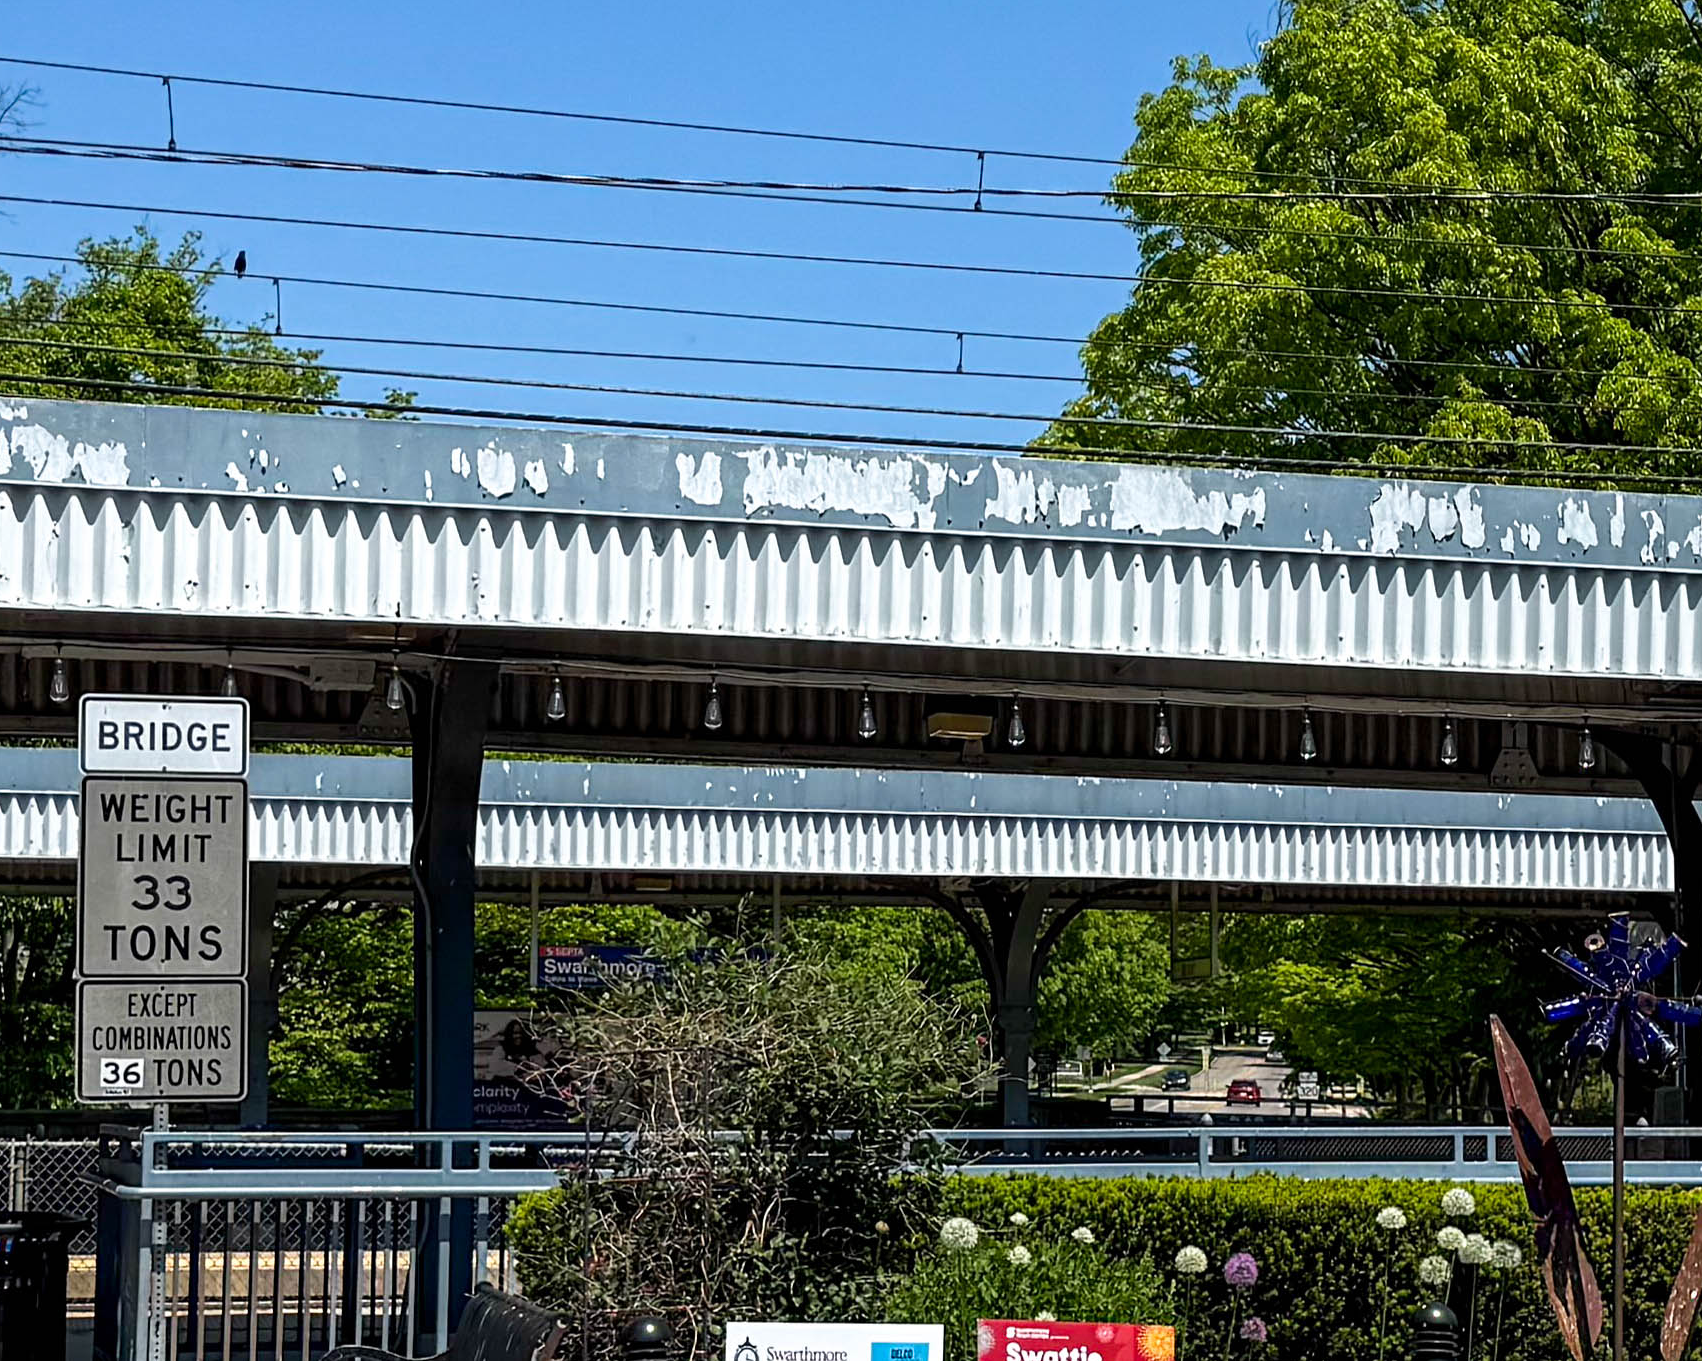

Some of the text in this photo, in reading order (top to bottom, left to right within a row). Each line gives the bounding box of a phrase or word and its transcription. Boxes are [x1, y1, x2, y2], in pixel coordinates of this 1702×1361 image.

[98, 721, 232, 753] BRIDGE
[100, 793, 233, 824] WEIGHT
[116, 834, 213, 863] LIMIT
[131, 874, 192, 911] 33
[104, 925, 223, 962] TONS
[544, 958, 657, 976] Swarhmore
[127, 993, 198, 1018] EXCEPT
[92, 1026, 232, 1051] COMBINATIONS
[103, 1059, 222, 1087] 36 TONS
[473, 1084, 520, 1102] clarity
[766, 1346, 848, 1361] Swarthmore
